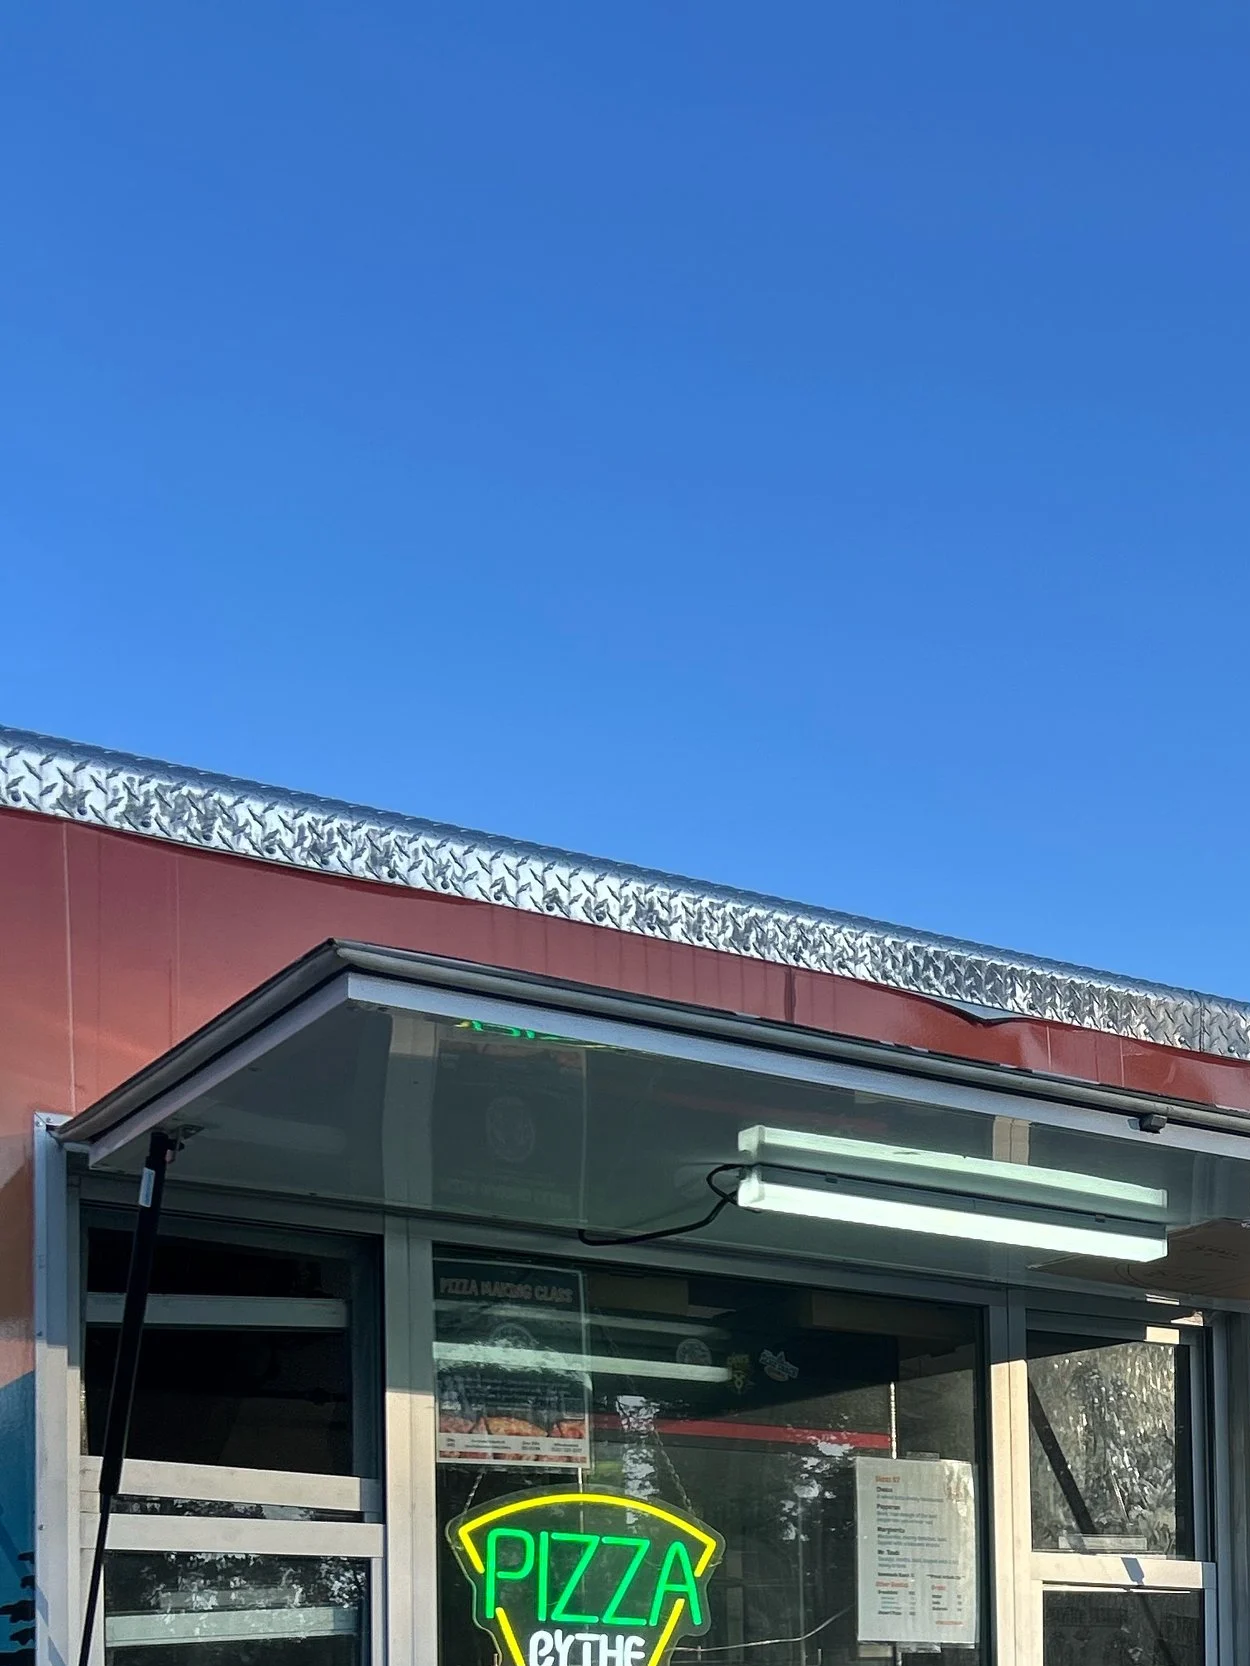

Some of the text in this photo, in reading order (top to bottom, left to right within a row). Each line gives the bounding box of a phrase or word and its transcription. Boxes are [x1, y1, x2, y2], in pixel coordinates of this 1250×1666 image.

[440, 1277, 479, 1296] PIZZA
[534, 1285, 573, 1303] CLASS
[486, 1527, 702, 1627] PIZZA
